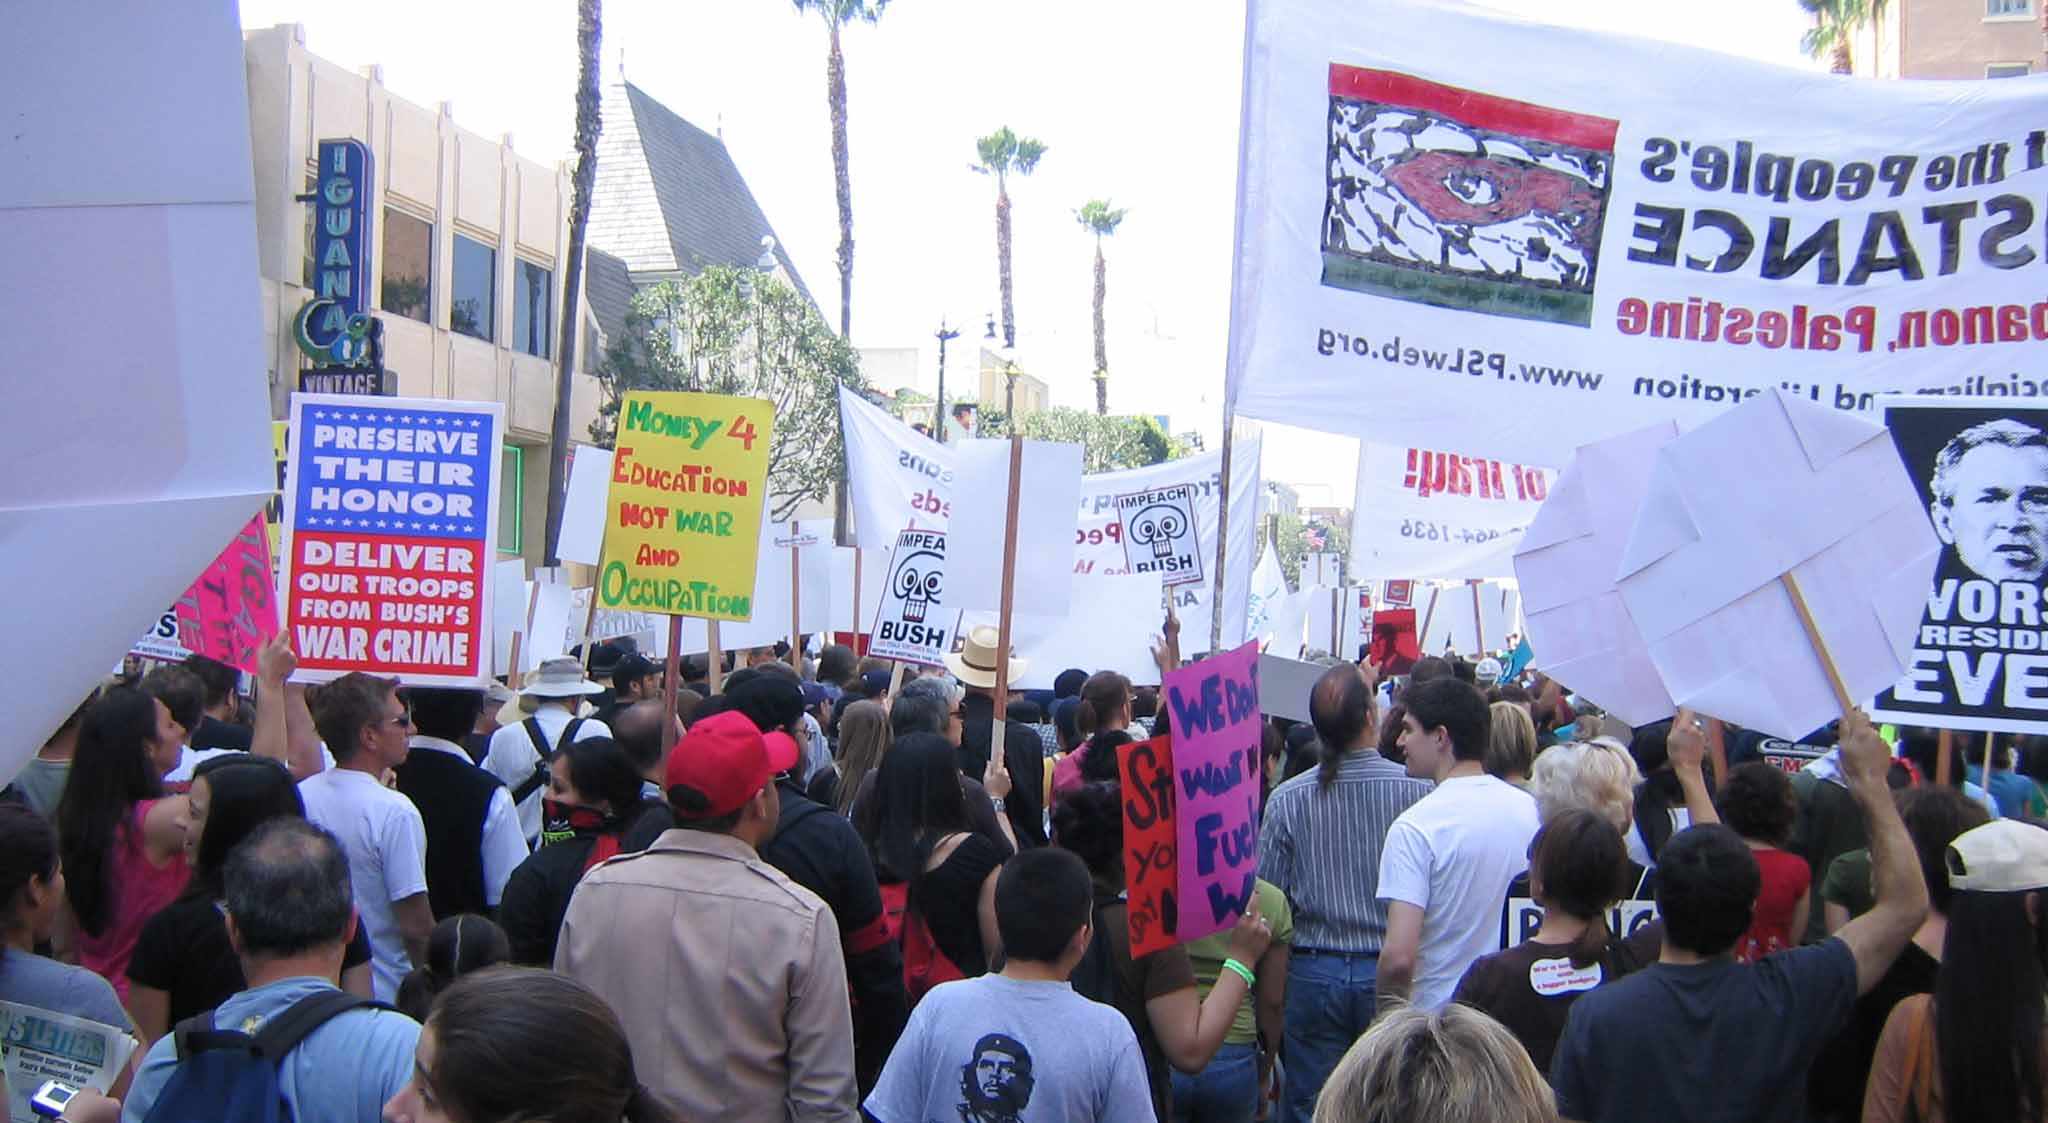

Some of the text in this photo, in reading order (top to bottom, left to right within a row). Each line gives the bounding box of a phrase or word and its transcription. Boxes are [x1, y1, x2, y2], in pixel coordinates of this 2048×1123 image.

[322, 145, 354, 333] IGUANA
[304, 374, 377, 393] VINTAGE
[313, 424, 478, 456] PRESERVE
[727, 415, 757, 450] 4
[313, 455, 475, 487] THEIR
[310, 486, 473, 518] HONOR
[1120, 487, 1188, 509] IMPEACH
[619, 502, 734, 537] NOT WAR
[303, 540, 474, 573] DELIVER
[635, 543, 680, 567] AND
[899, 533, 946, 552] IMPEA
[299, 573, 474, 600] OUR TROOPS
[300, 598, 470, 626] FROM BUSH'S
[296, 625, 468, 666] WAR CRIME
[880, 620, 945, 649] BUSH
[1169, 673, 1225, 740] WE
